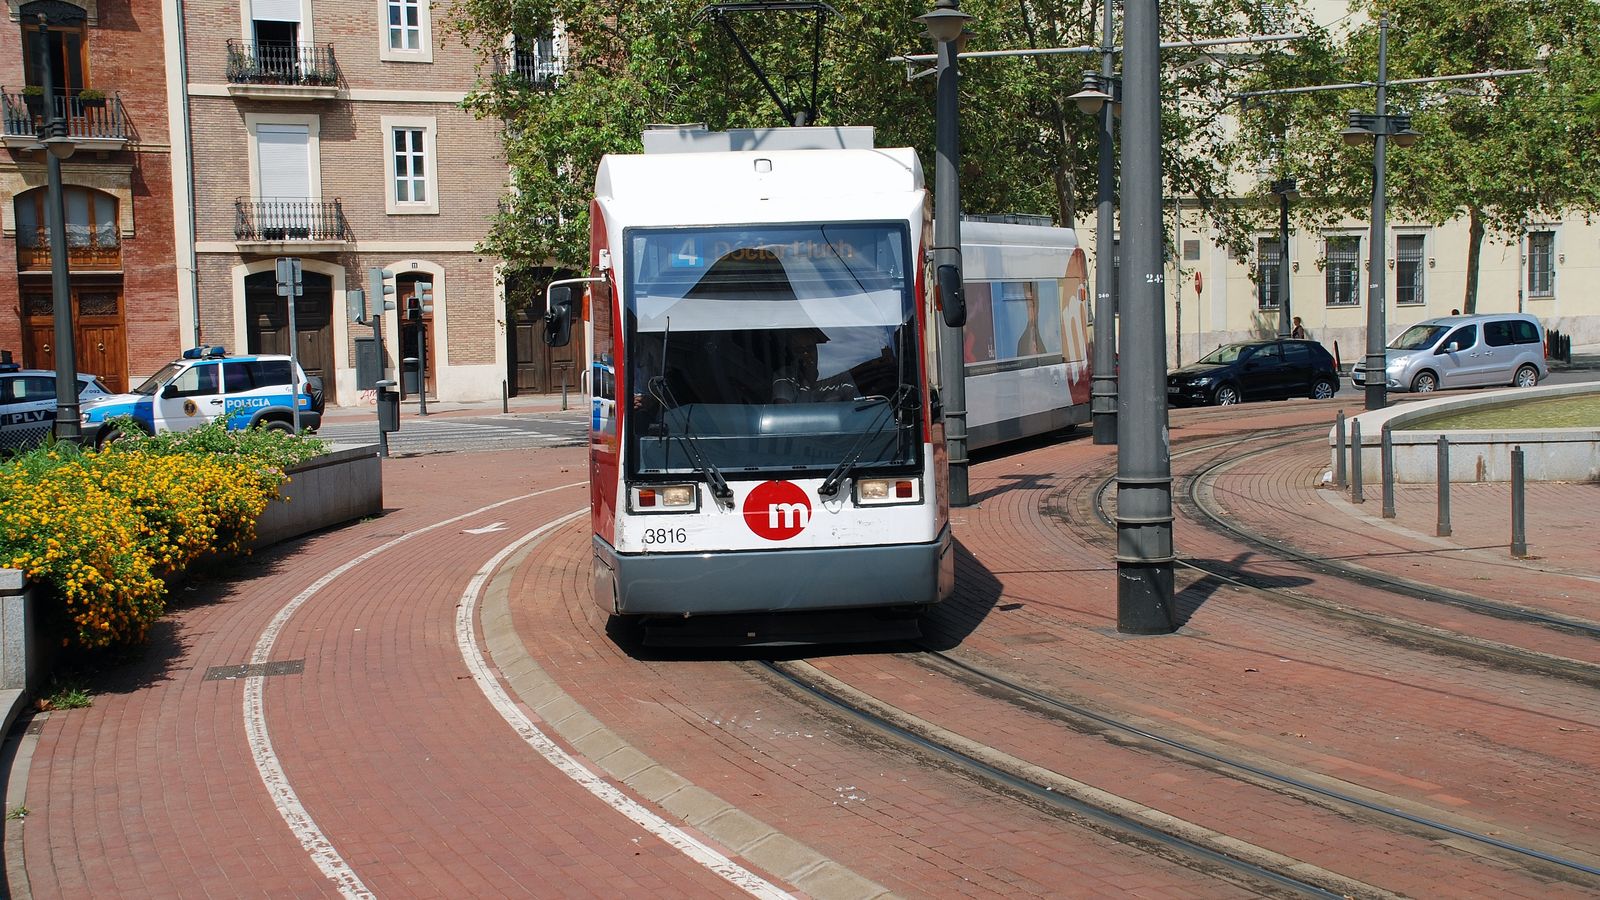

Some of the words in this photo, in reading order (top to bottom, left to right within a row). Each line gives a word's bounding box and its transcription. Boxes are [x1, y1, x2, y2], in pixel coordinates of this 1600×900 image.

[678, 238, 698, 265] 4
[714, 240, 785, 260] Doctor
[226, 398, 271, 409] POLICIA
[12, 410, 46, 424] PLV
[768, 502, 809, 529] m
[644, 528, 687, 544] 3816
